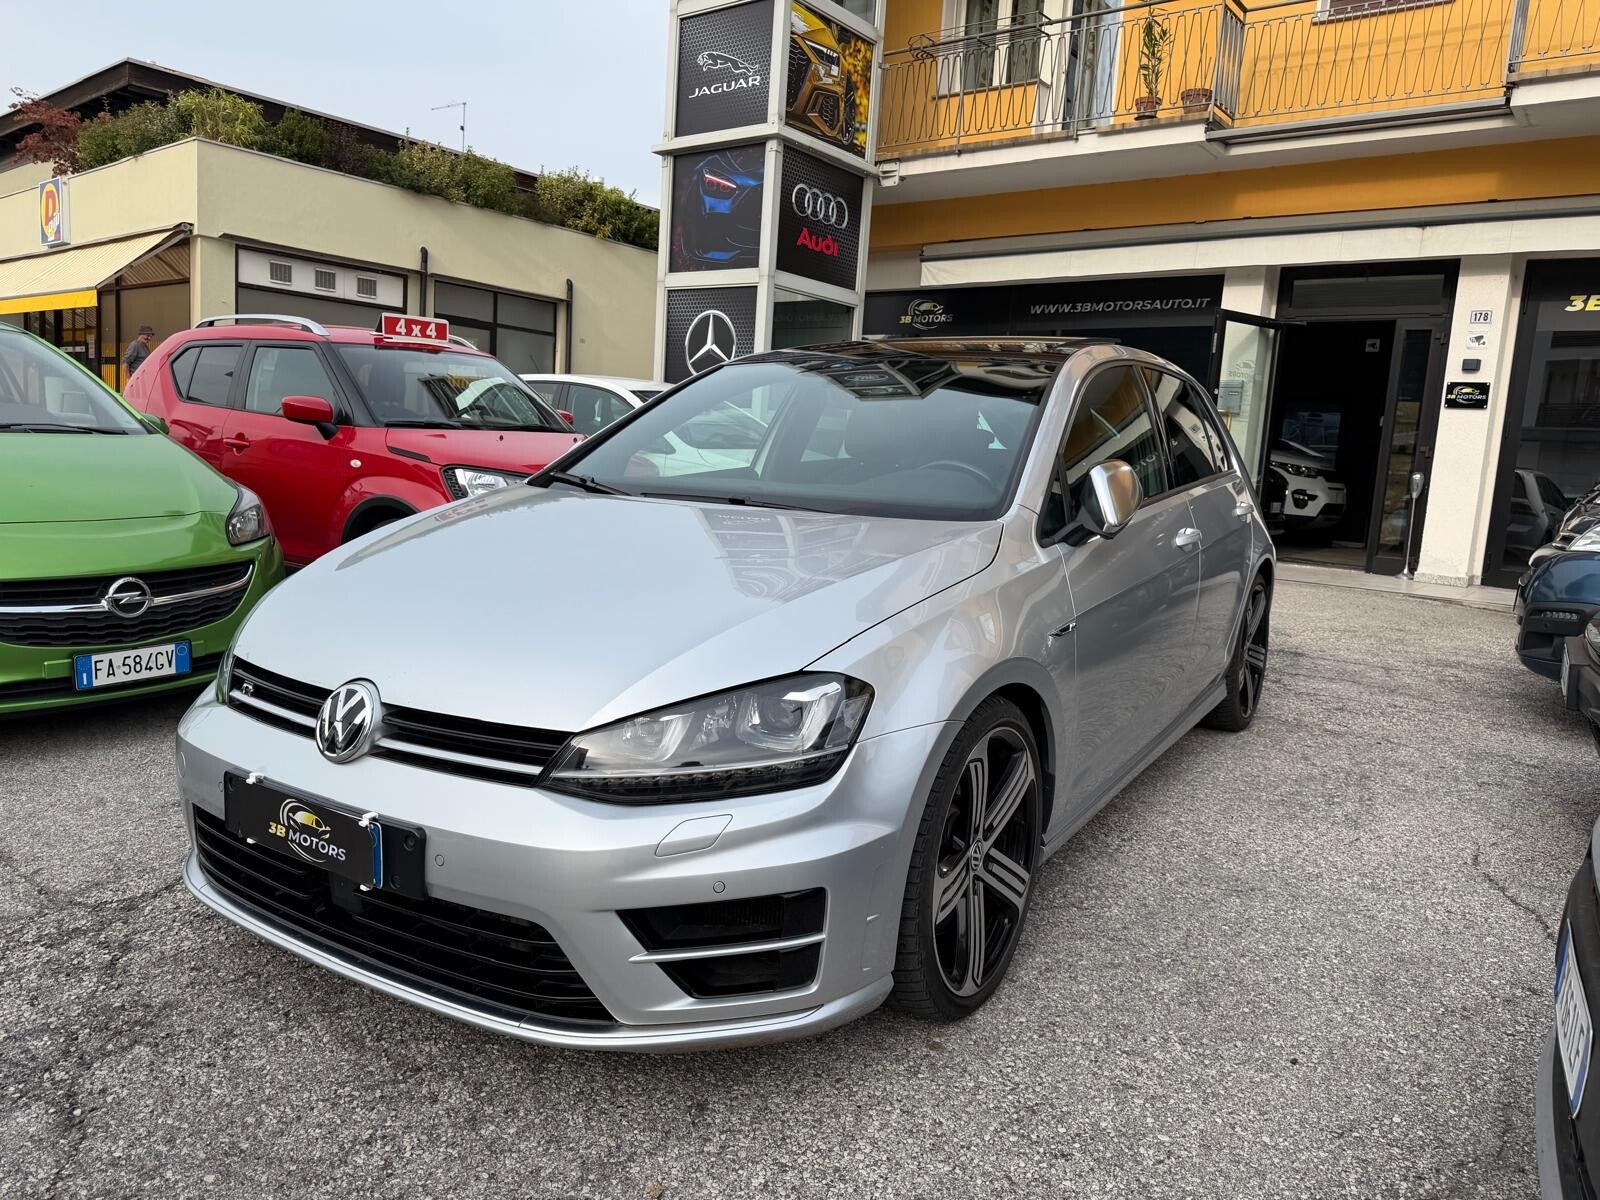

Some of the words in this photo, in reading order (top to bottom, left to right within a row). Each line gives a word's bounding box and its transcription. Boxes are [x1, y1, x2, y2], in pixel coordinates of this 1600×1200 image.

[688, 76, 760, 98] JAGUAR
[797, 227, 838, 256] Audi
[1030, 298, 1210, 314] WWW.3BMOTORSAUTO.IT
[899, 316, 912, 324] 3B
[912, 314, 953, 323] MOTORS
[1474, 312, 1489, 322] 178
[395, 318, 406, 335] 4
[426, 322, 437, 338] 4
[268, 822, 286, 838] 3B
[288, 828, 346, 861] MOTORS
